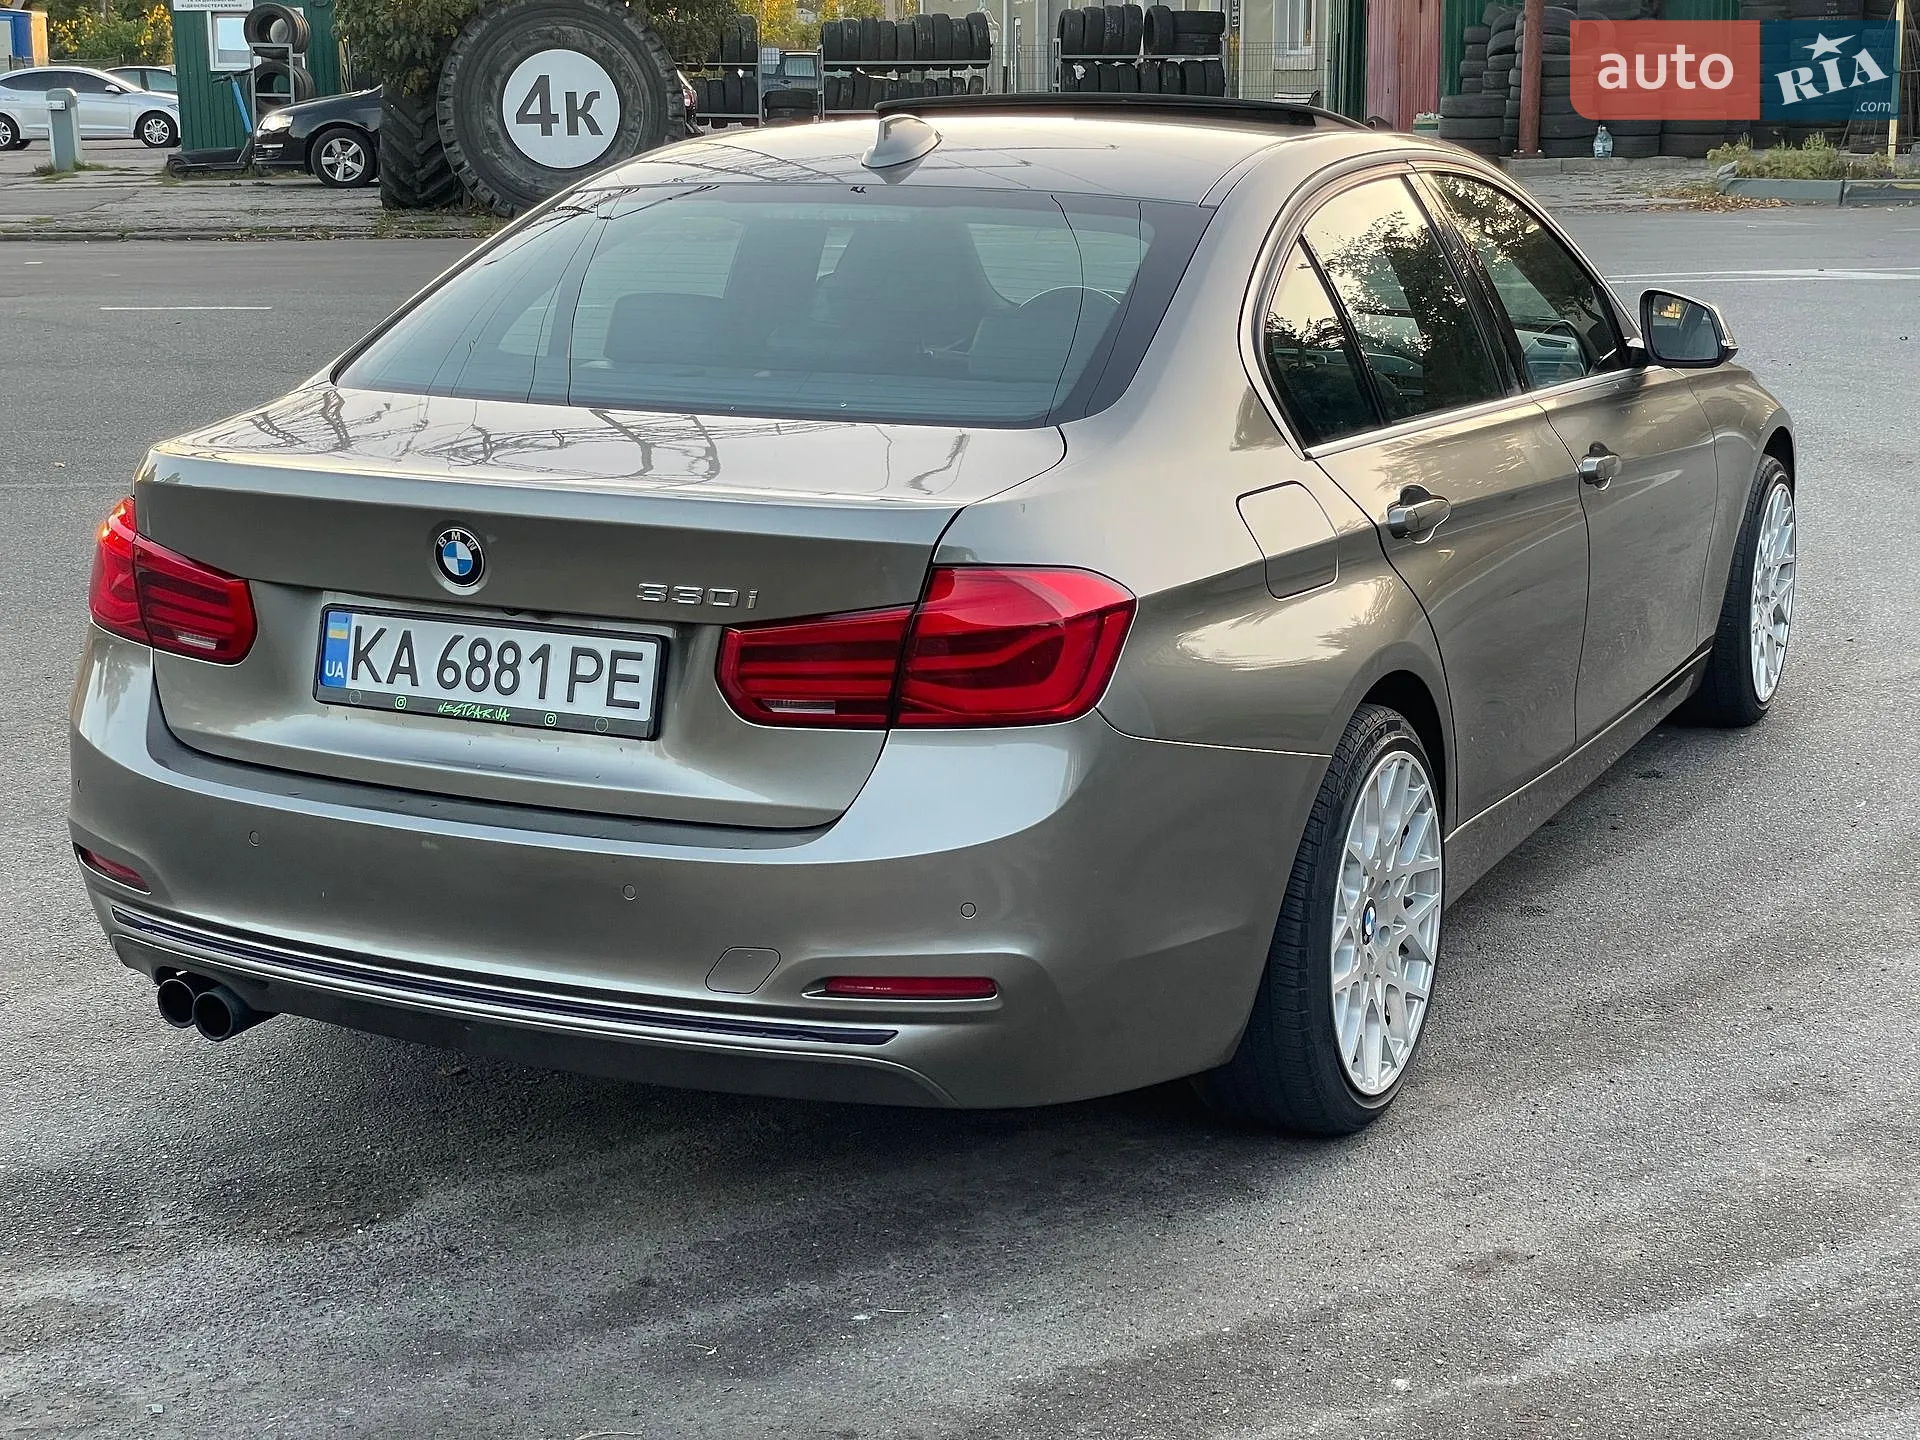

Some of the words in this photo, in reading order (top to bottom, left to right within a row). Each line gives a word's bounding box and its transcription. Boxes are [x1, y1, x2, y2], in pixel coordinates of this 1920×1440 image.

[437, 531, 477, 552] BMW
[636, 582, 760, 610] 330i
[325, 660, 345, 680] UA
[351, 625, 420, 687] KA
[436, 634, 552, 700] 6881
[567, 645, 644, 710] PE
